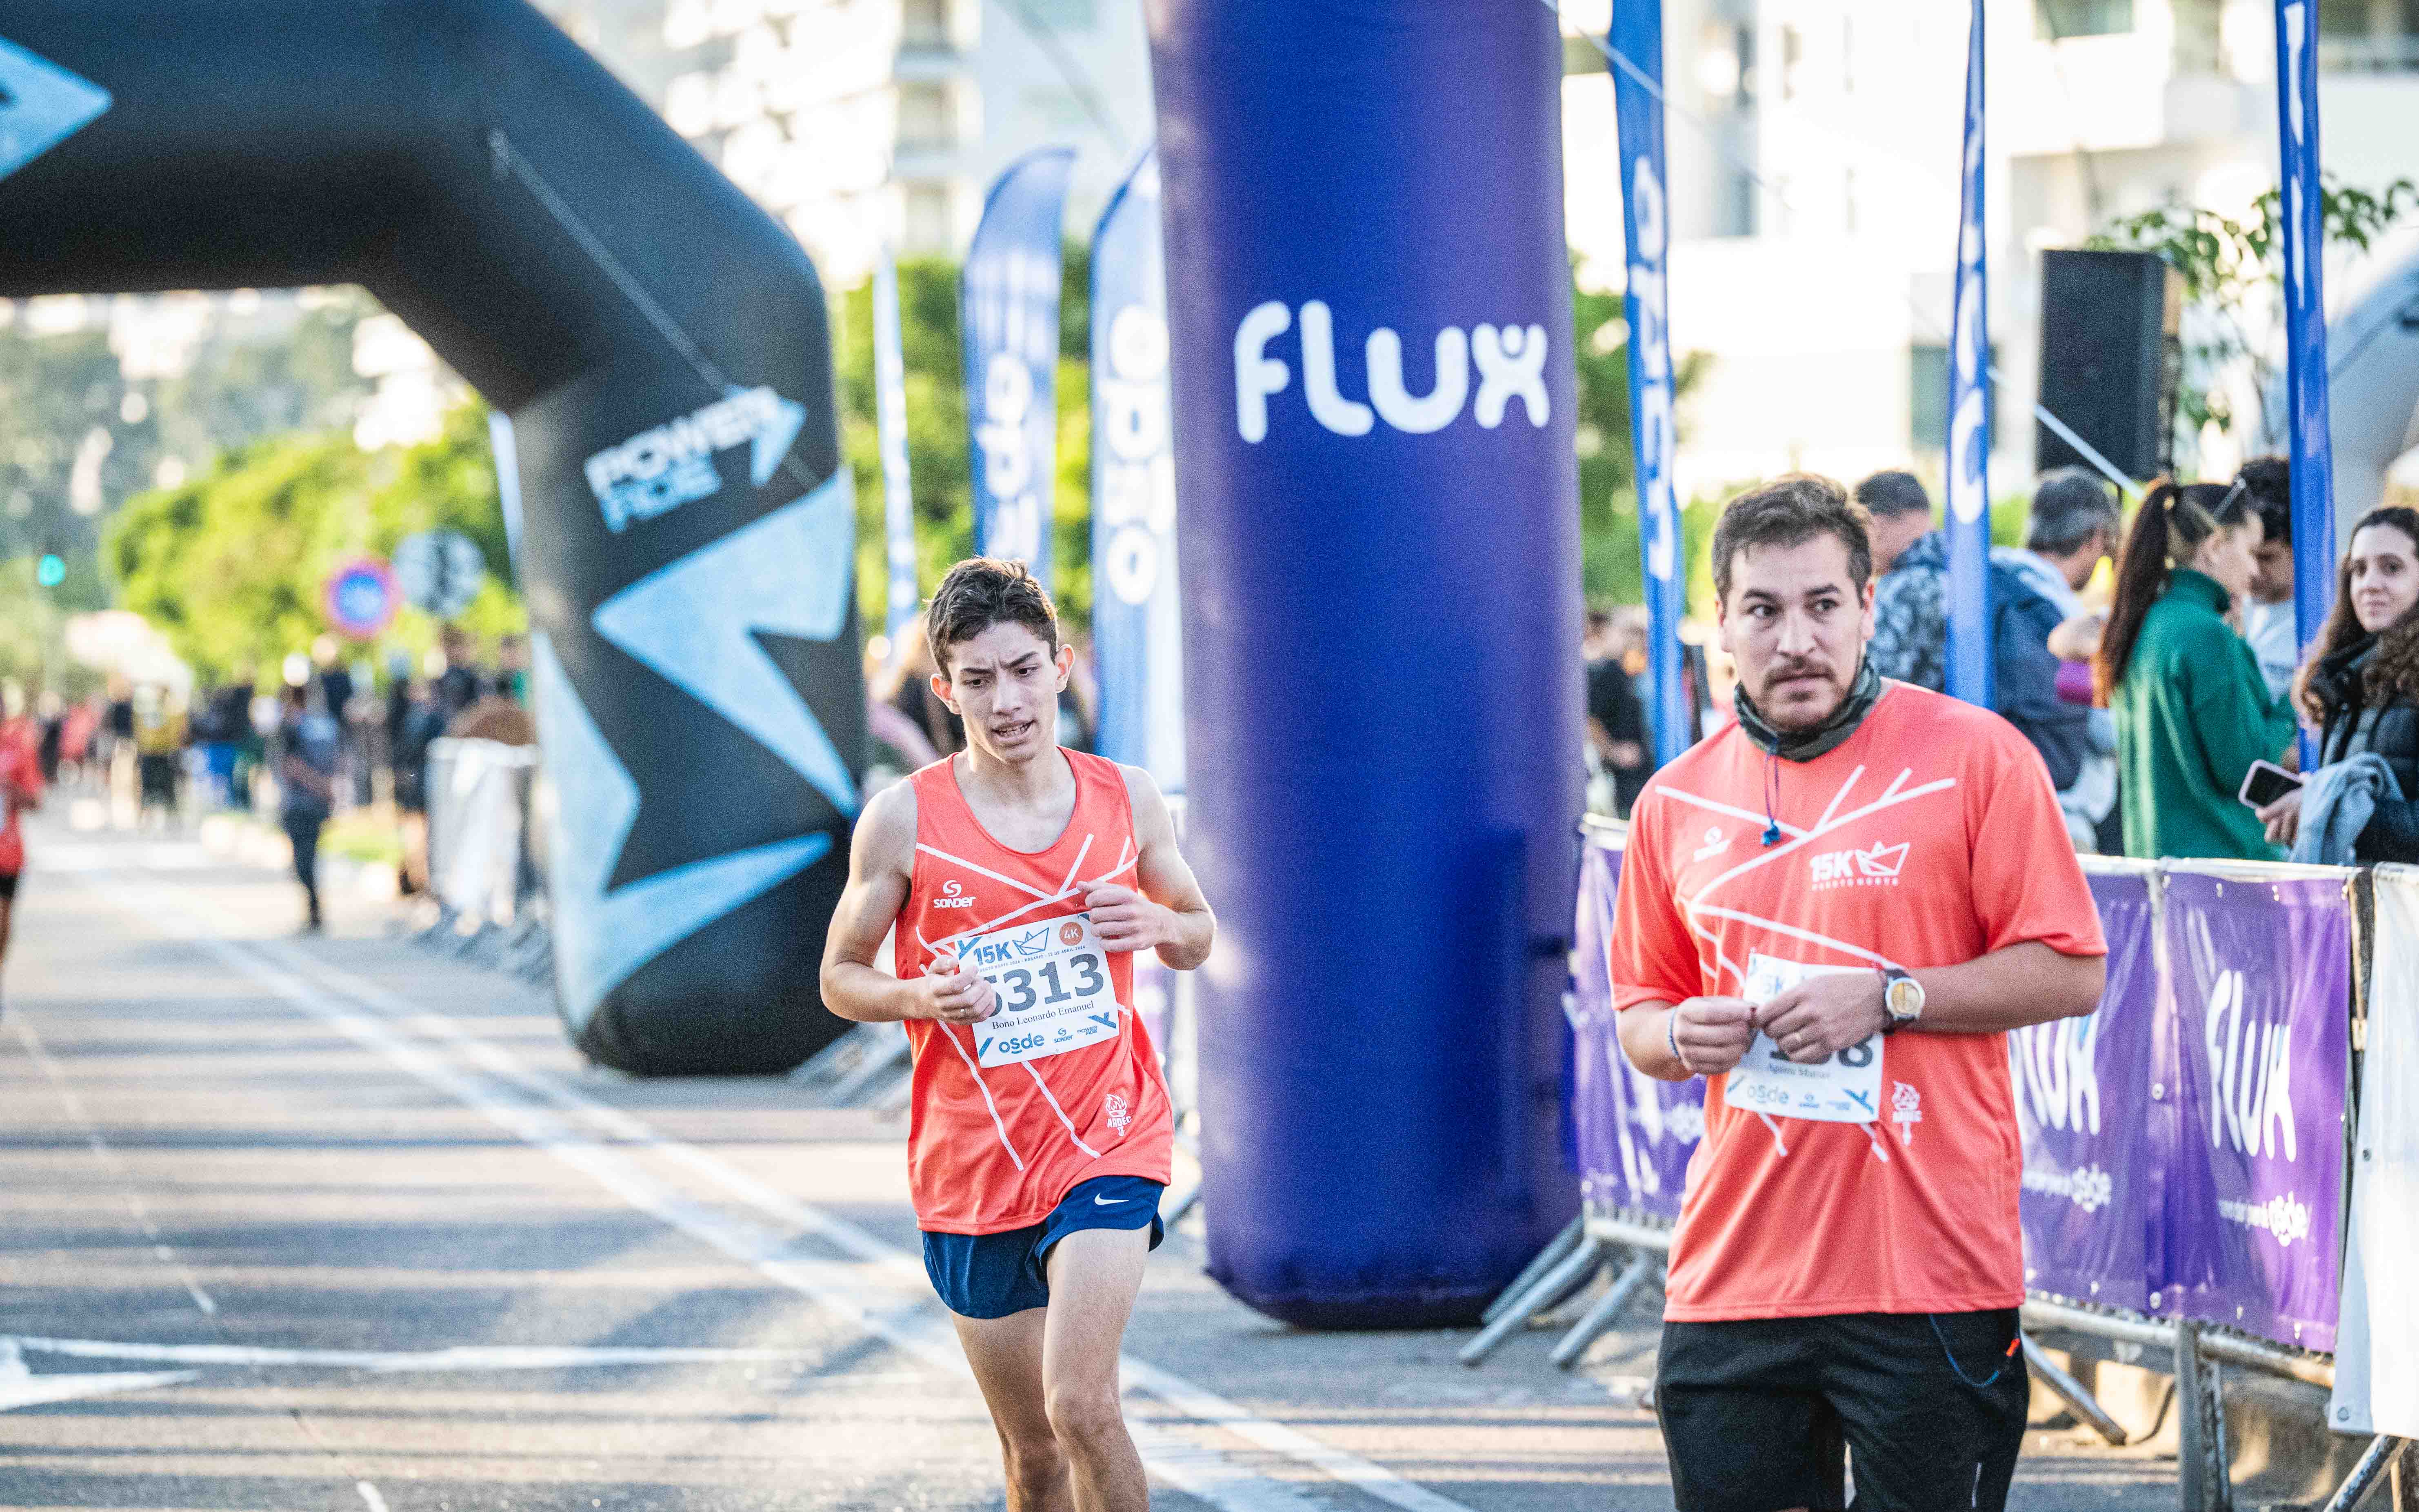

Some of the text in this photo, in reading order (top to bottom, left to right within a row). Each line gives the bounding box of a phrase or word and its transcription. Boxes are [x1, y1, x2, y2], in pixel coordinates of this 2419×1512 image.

[1809, 849, 1854, 882] 15K
[1064, 929, 1079, 939] 4K
[973, 941, 1013, 966] 15K
[1017, 1010, 1056, 1026] Leonardo
[1059, 1000, 1094, 1016] Emanuel
[998, 1032, 1045, 1054] osde
[1107, 1116, 1132, 1128] ARDEC
